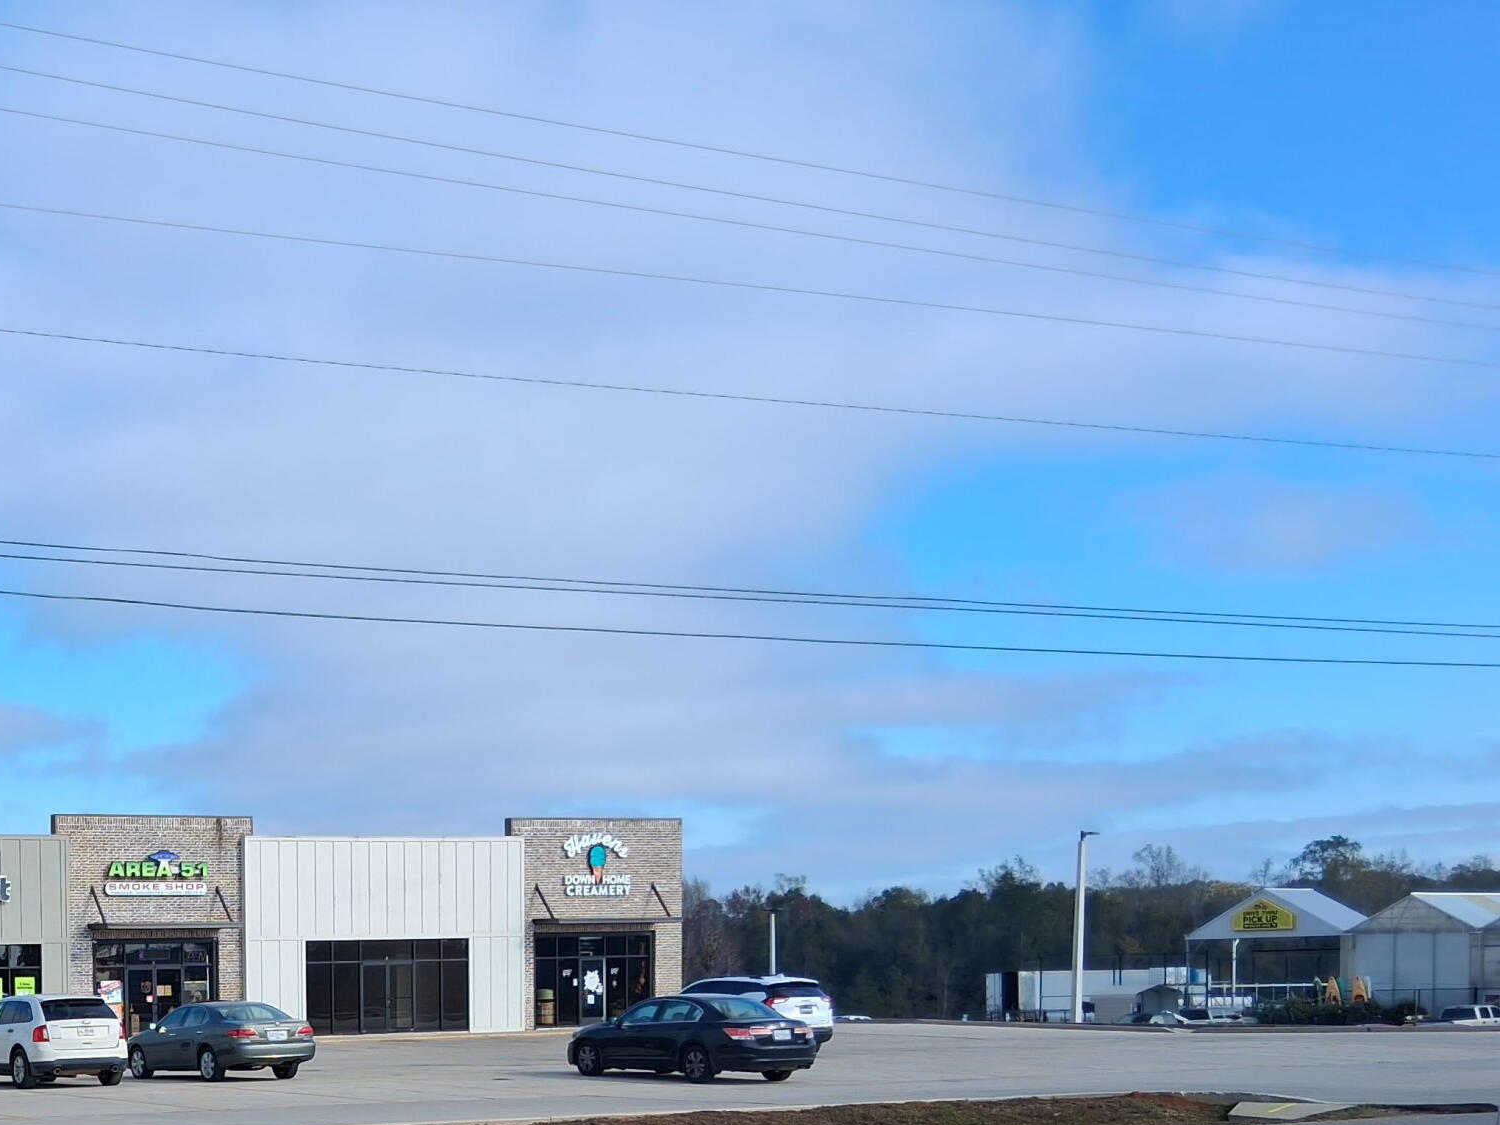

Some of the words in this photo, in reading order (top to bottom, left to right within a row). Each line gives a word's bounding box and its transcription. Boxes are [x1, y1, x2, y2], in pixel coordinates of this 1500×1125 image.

[108, 861, 173, 877] AREA
[180, 861, 210, 877] 51
[564, 875, 596, 885] DOWN
[602, 875, 631, 884] HOME
[108, 883, 160, 891] SMOKE
[165, 883, 204, 891] SHOP
[566, 885, 631, 896] CREAMERY
